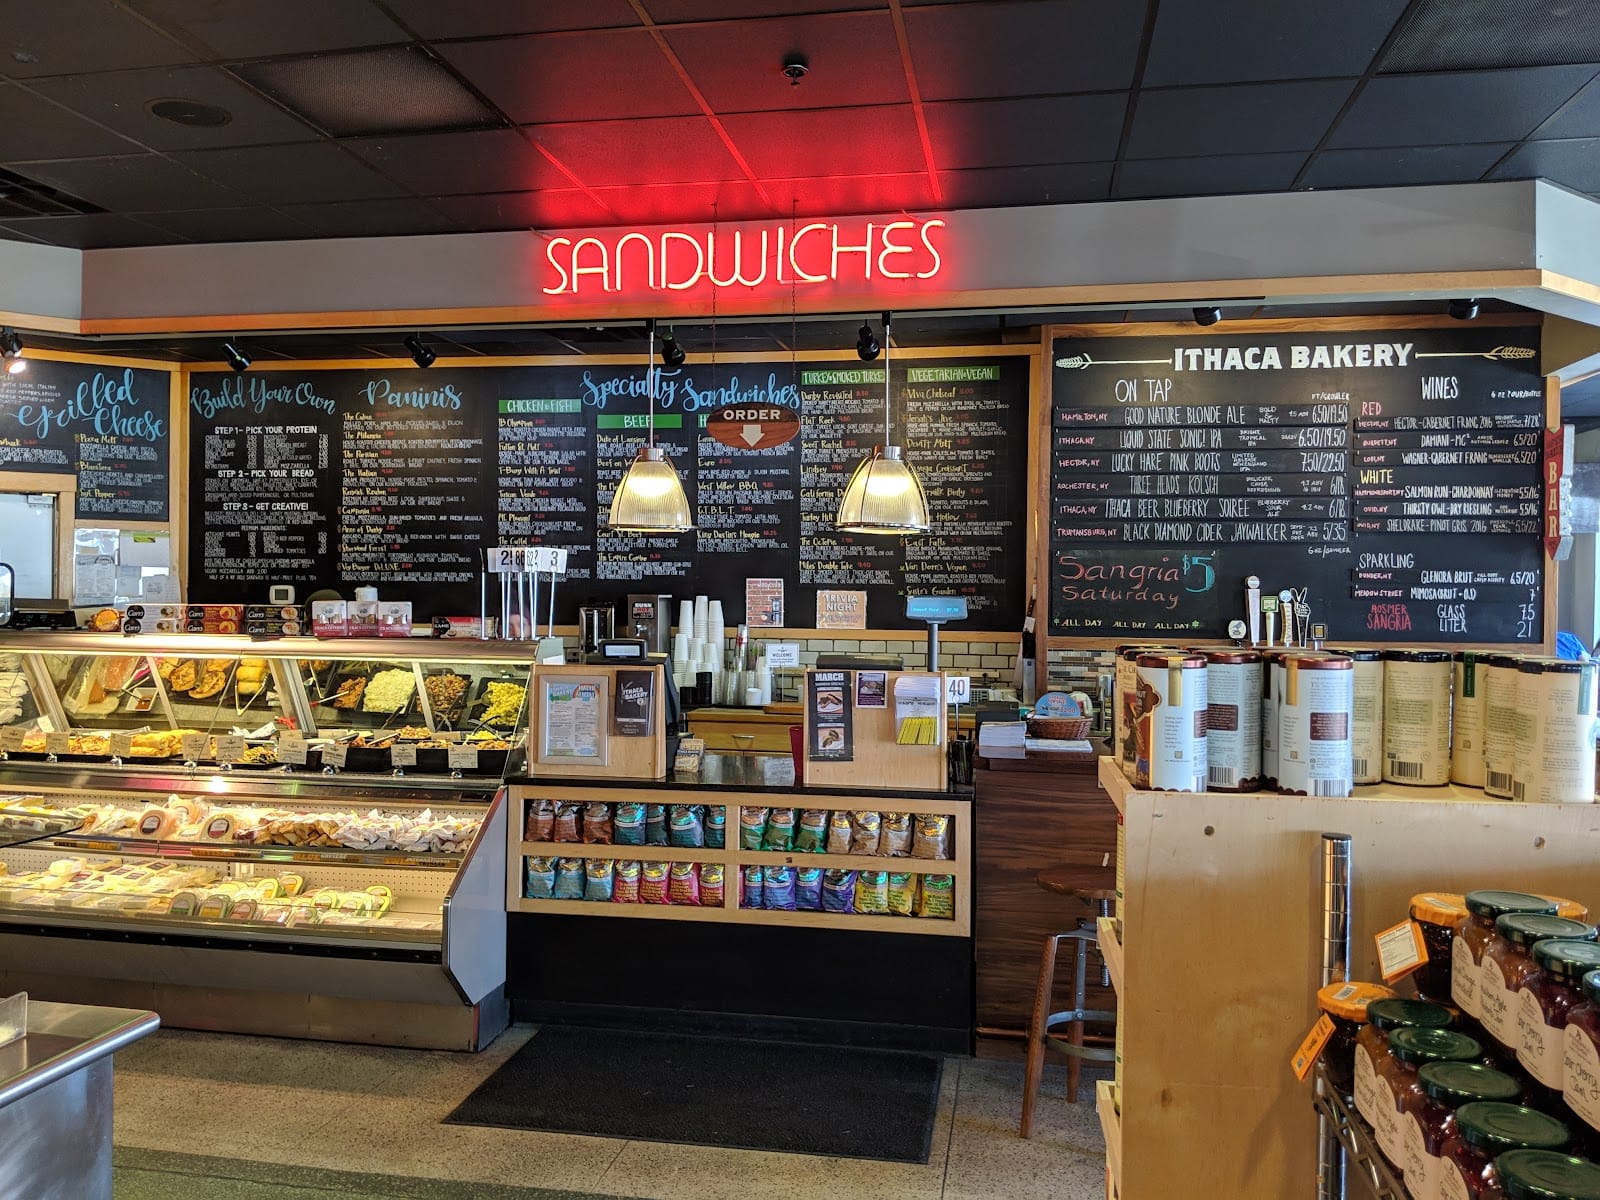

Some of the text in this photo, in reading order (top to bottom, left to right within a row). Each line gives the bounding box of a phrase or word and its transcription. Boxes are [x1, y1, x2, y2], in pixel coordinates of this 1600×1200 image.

[543, 219, 944, 295] SANDWICHES
[1174, 343, 1414, 371] ITHACA BAKERY
[862, 370, 886, 383] TURKE
[911, 368, 993, 381] VEGETARIAN VEGAN
[358, 379, 462, 410] Paninis
[579, 367, 800, 412] Specialty Sandwiches
[1115, 378, 1173, 403] ON TAP
[1421, 376, 1458, 400] WINES
[8, 367, 140, 440] Grilled
[191, 376, 336, 419] Build Your Own
[506, 400, 573, 413] CHICKEN FISH
[723, 409, 781, 421] ORDER
[1124, 407, 1145, 425] GOOD
[1147, 406, 1182, 425] NATURE
[1187, 406, 1221, 425] BLONDE
[1226, 405, 1246, 425] ALE
[1312, 404, 1348, 424] 6.50/19.50
[1361, 402, 1382, 416] RED
[84, 404, 167, 442] Cheese
[214, 425, 318, 435] STEP PICK YOUR PROTEIN
[623, 415, 650, 428] BEEF
[1457, 415, 1479, 429] FRANC
[1120, 430, 1144, 449] LIQUID
[1148, 429, 1174, 449] STATE
[1210, 429, 1223, 449] IPA
[1298, 427, 1346, 447] 6.50/19.50
[1420, 434, 1450, 448] DAMIANI
[1111, 453, 1135, 473] LUCKY
[1139, 452, 1165, 472] HARE
[1169, 452, 1190, 472] PINK
[1194, 452, 1221, 472] BOOTS
[1300, 451, 1345, 472] 7.50/22.50
[1464, 451, 1488, 464] FRANC
[217, 469, 315, 478] STEP PICK YOUR BREAD
[1360, 469, 1394, 484] WHITE
[1128, 475, 1152, 495] THREE
[1157, 475, 1180, 495] HEADS
[1404, 486, 1433, 499] SALMON
[222, 502, 309, 511] STEP GET CREATIVE!
[1105, 499, 1131, 518] ITHACA
[1137, 498, 1160, 518] BEER
[1164, 498, 1210, 518] BLUEBERRY
[1547, 461, 1559, 538] BAR
[1123, 523, 1150, 542] BLACK
[1154, 522, 1193, 541] DIAMOND
[1196, 522, 1223, 542] CIDER
[1230, 522, 1288, 541] JAYWALKER
[1322, 522, 1346, 541] 5/35
[1430, 519, 1450, 532] PINOT
[1358, 553, 1415, 569] SPARKLING
[1058, 553, 1216, 593] Sangria $5
[1420, 570, 1474, 584] GLENORA BRUT
[825, 594, 859, 603] TRIVIA
[1061, 586, 1180, 610] Saturday
[826, 602, 858, 612] NIGHT
[1437, 603, 1465, 620] GLASS
[1061, 618, 1190, 630] ALL DAY ALL DAY ALL DAY
[1366, 614, 1532, 638] SANGRIA LITER 21
[814, 672, 845, 682] MARCH
[622, 686, 645, 696] ITHACA
[625, 690, 649, 700] BAKERY
[949, 679, 966, 697] 40
